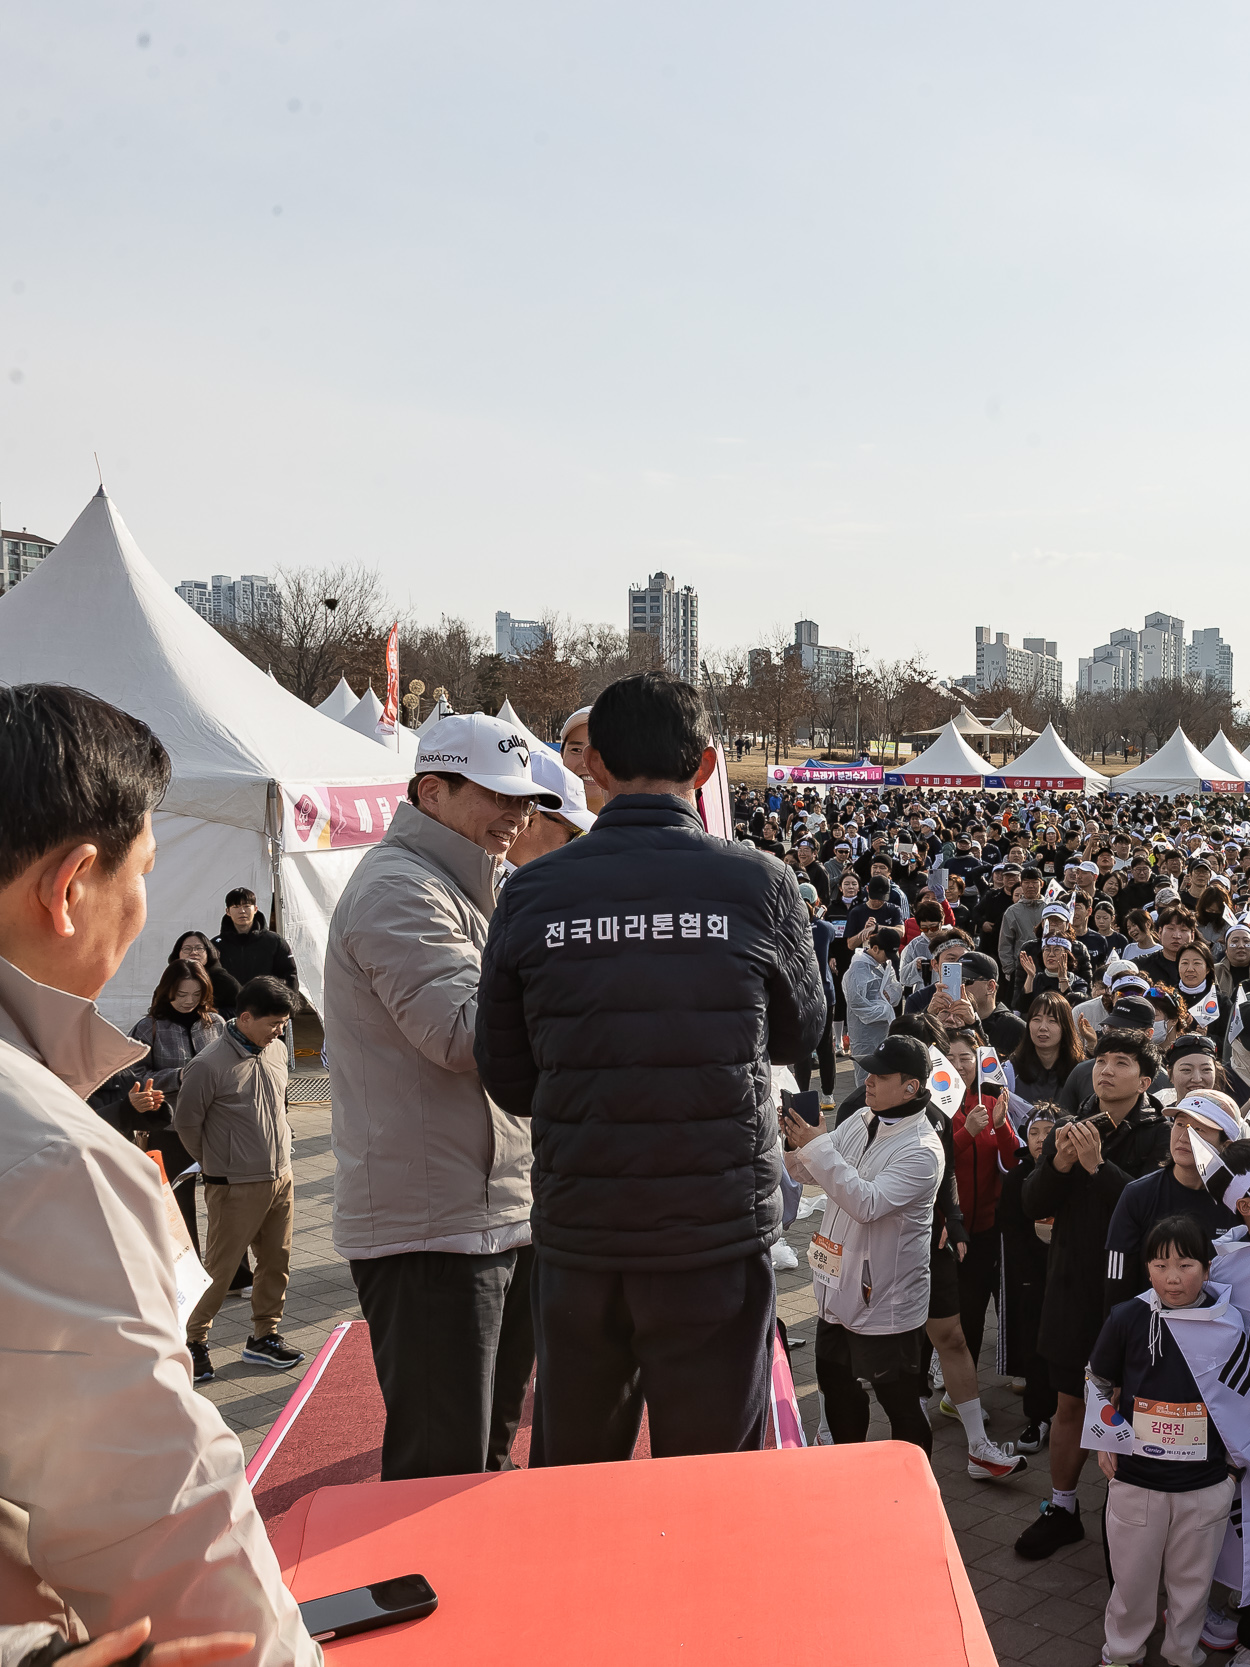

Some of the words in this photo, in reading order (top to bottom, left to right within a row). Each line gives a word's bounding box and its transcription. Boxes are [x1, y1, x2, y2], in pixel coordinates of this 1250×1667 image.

[420, 753, 468, 764] PARADYM
[813, 770, 835, 781] 쓰레기
[837, 770, 868, 781] 분리수거
[544, 912, 729, 948] 전국마라톤협회
[1151, 1420, 1185, 1436] 김연진
[1161, 1436, 1176, 1445] 872
